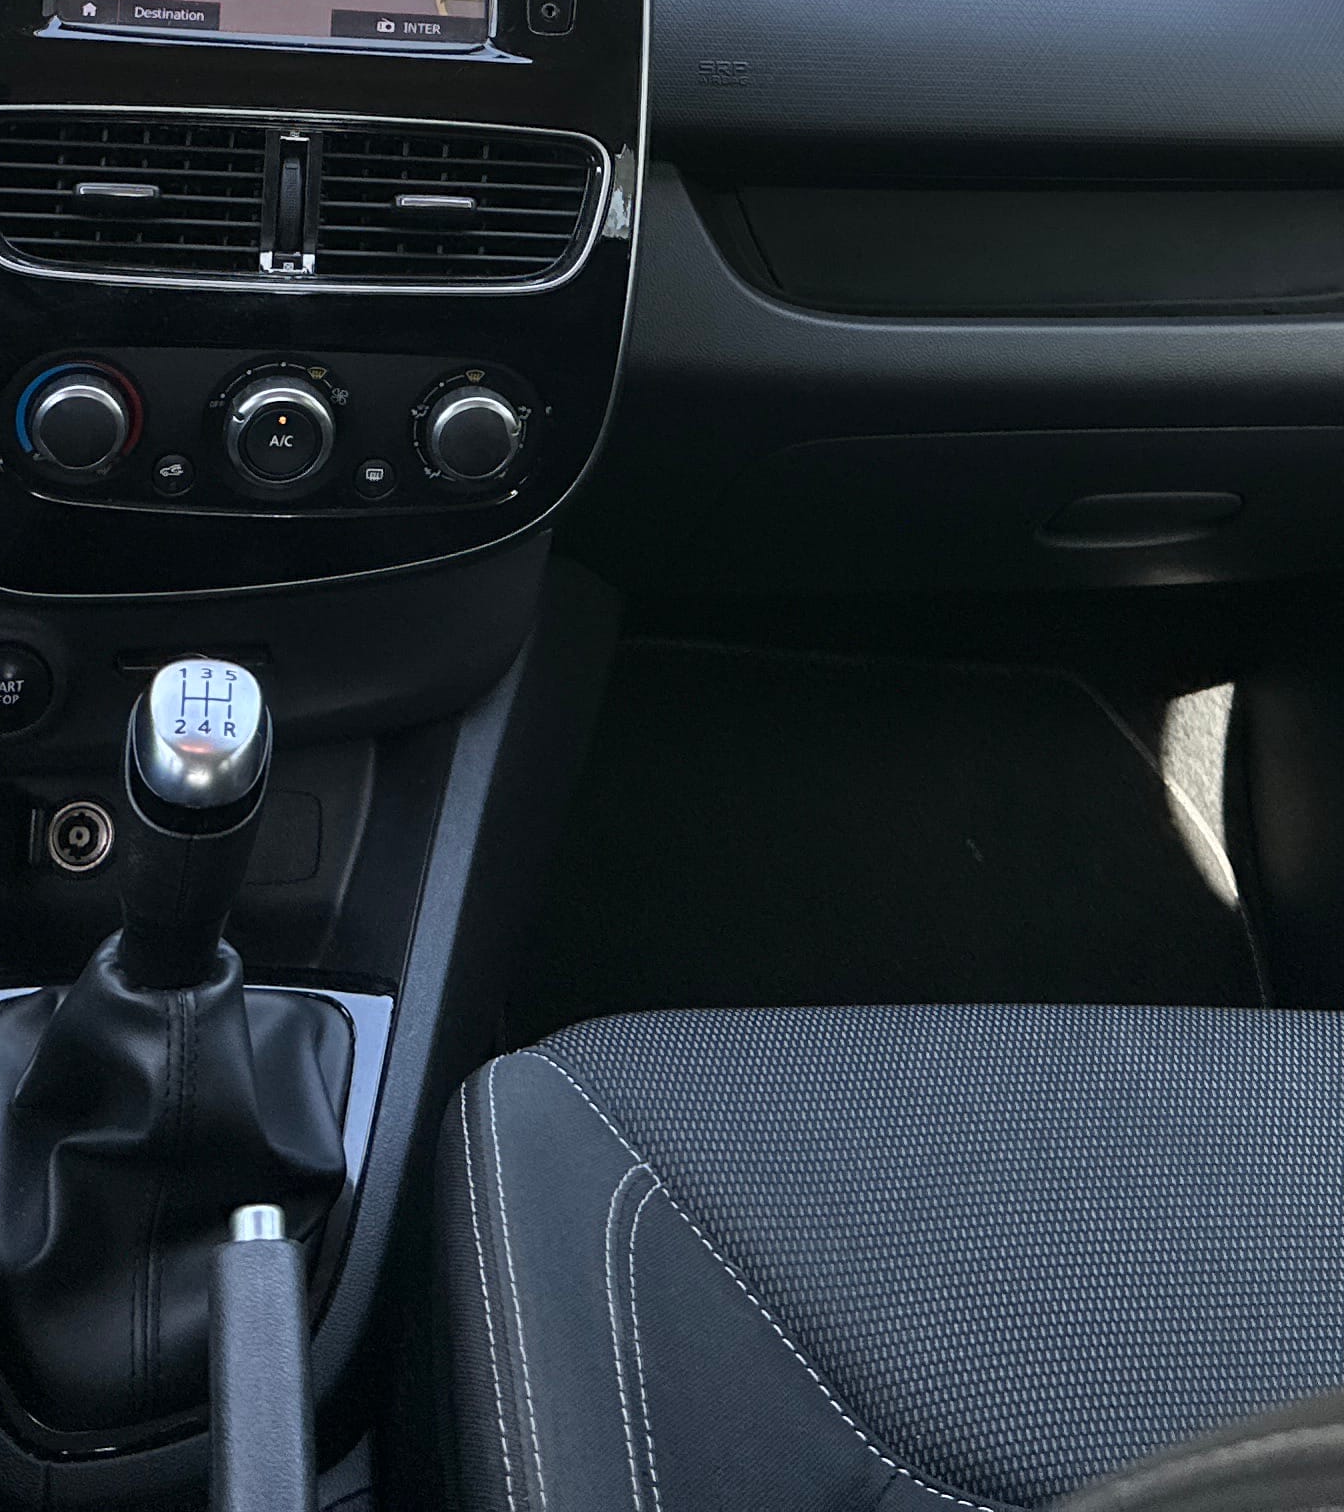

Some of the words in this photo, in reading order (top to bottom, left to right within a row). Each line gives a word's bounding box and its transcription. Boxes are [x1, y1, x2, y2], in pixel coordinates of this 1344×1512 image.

[134, 6, 206, 22] Destination
[403, 22, 441, 35] INTER
[268, 434, 294, 447] A/C
[178, 667, 187, 679] 1
[200, 667, 214, 679] 3
[224, 669, 238, 682] 5
[174, 719, 187, 735] 2
[197, 719, 212, 734] 4
[223, 721, 237, 738] R
